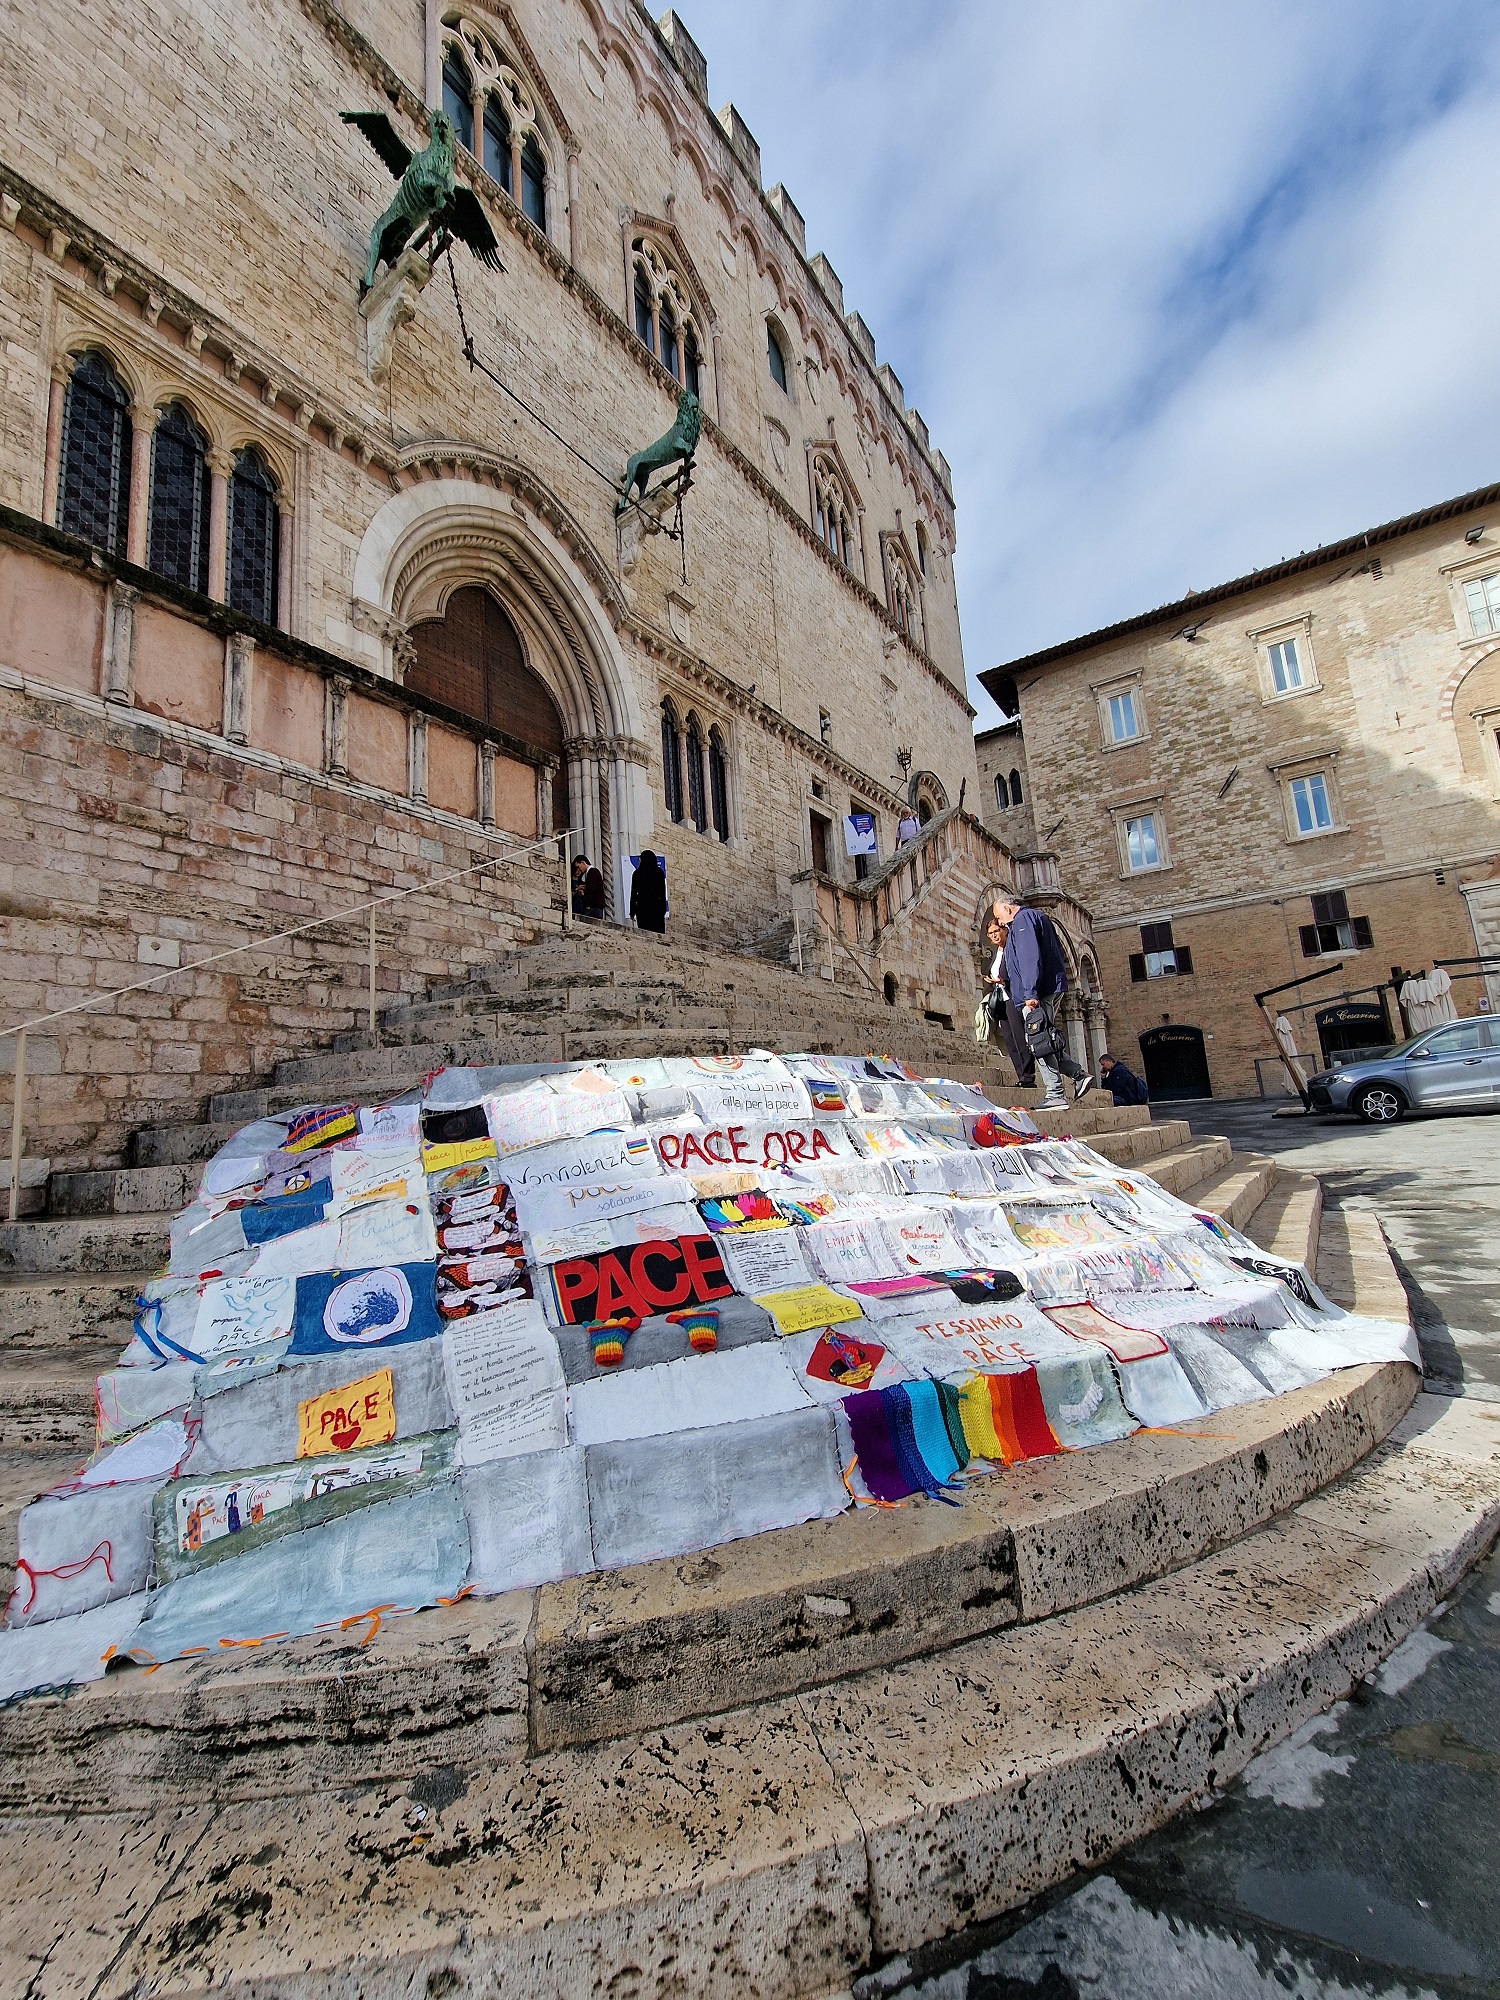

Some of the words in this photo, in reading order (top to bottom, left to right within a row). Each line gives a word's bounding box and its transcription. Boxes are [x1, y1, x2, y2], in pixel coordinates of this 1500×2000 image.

[1322, 1016, 1334, 1025] da
[1336, 1010, 1381, 1021] Cesarino
[1147, 1036, 1157, 1045] da
[1158, 1032, 1195, 1042] Cesarino
[745, 1099, 763, 1113] per
[764, 1096, 775, 1109] la
[775, 1099, 800, 1114] pace
[465, 1143, 490, 1159] pace
[658, 1125, 758, 1170] PACE
[763, 1128, 840, 1164] ORA
[839, 1246, 868, 1260] PACE
[555, 1233, 733, 1325] PACE
[459, 1312, 497, 1327] INVOCARE
[501, 1306, 510, 1315] LA
[513, 1301, 532, 1310] PACE
[837, 1306, 854, 1317] TE
[915, 1313, 1024, 1340] TESSIAMO
[218, 1327, 265, 1345] PACE
[969, 1334, 994, 1348] LA
[962, 1342, 1036, 1365] PACE
[320, 1392, 380, 1435] PACE
[212, 1514, 227, 1525] PACE
